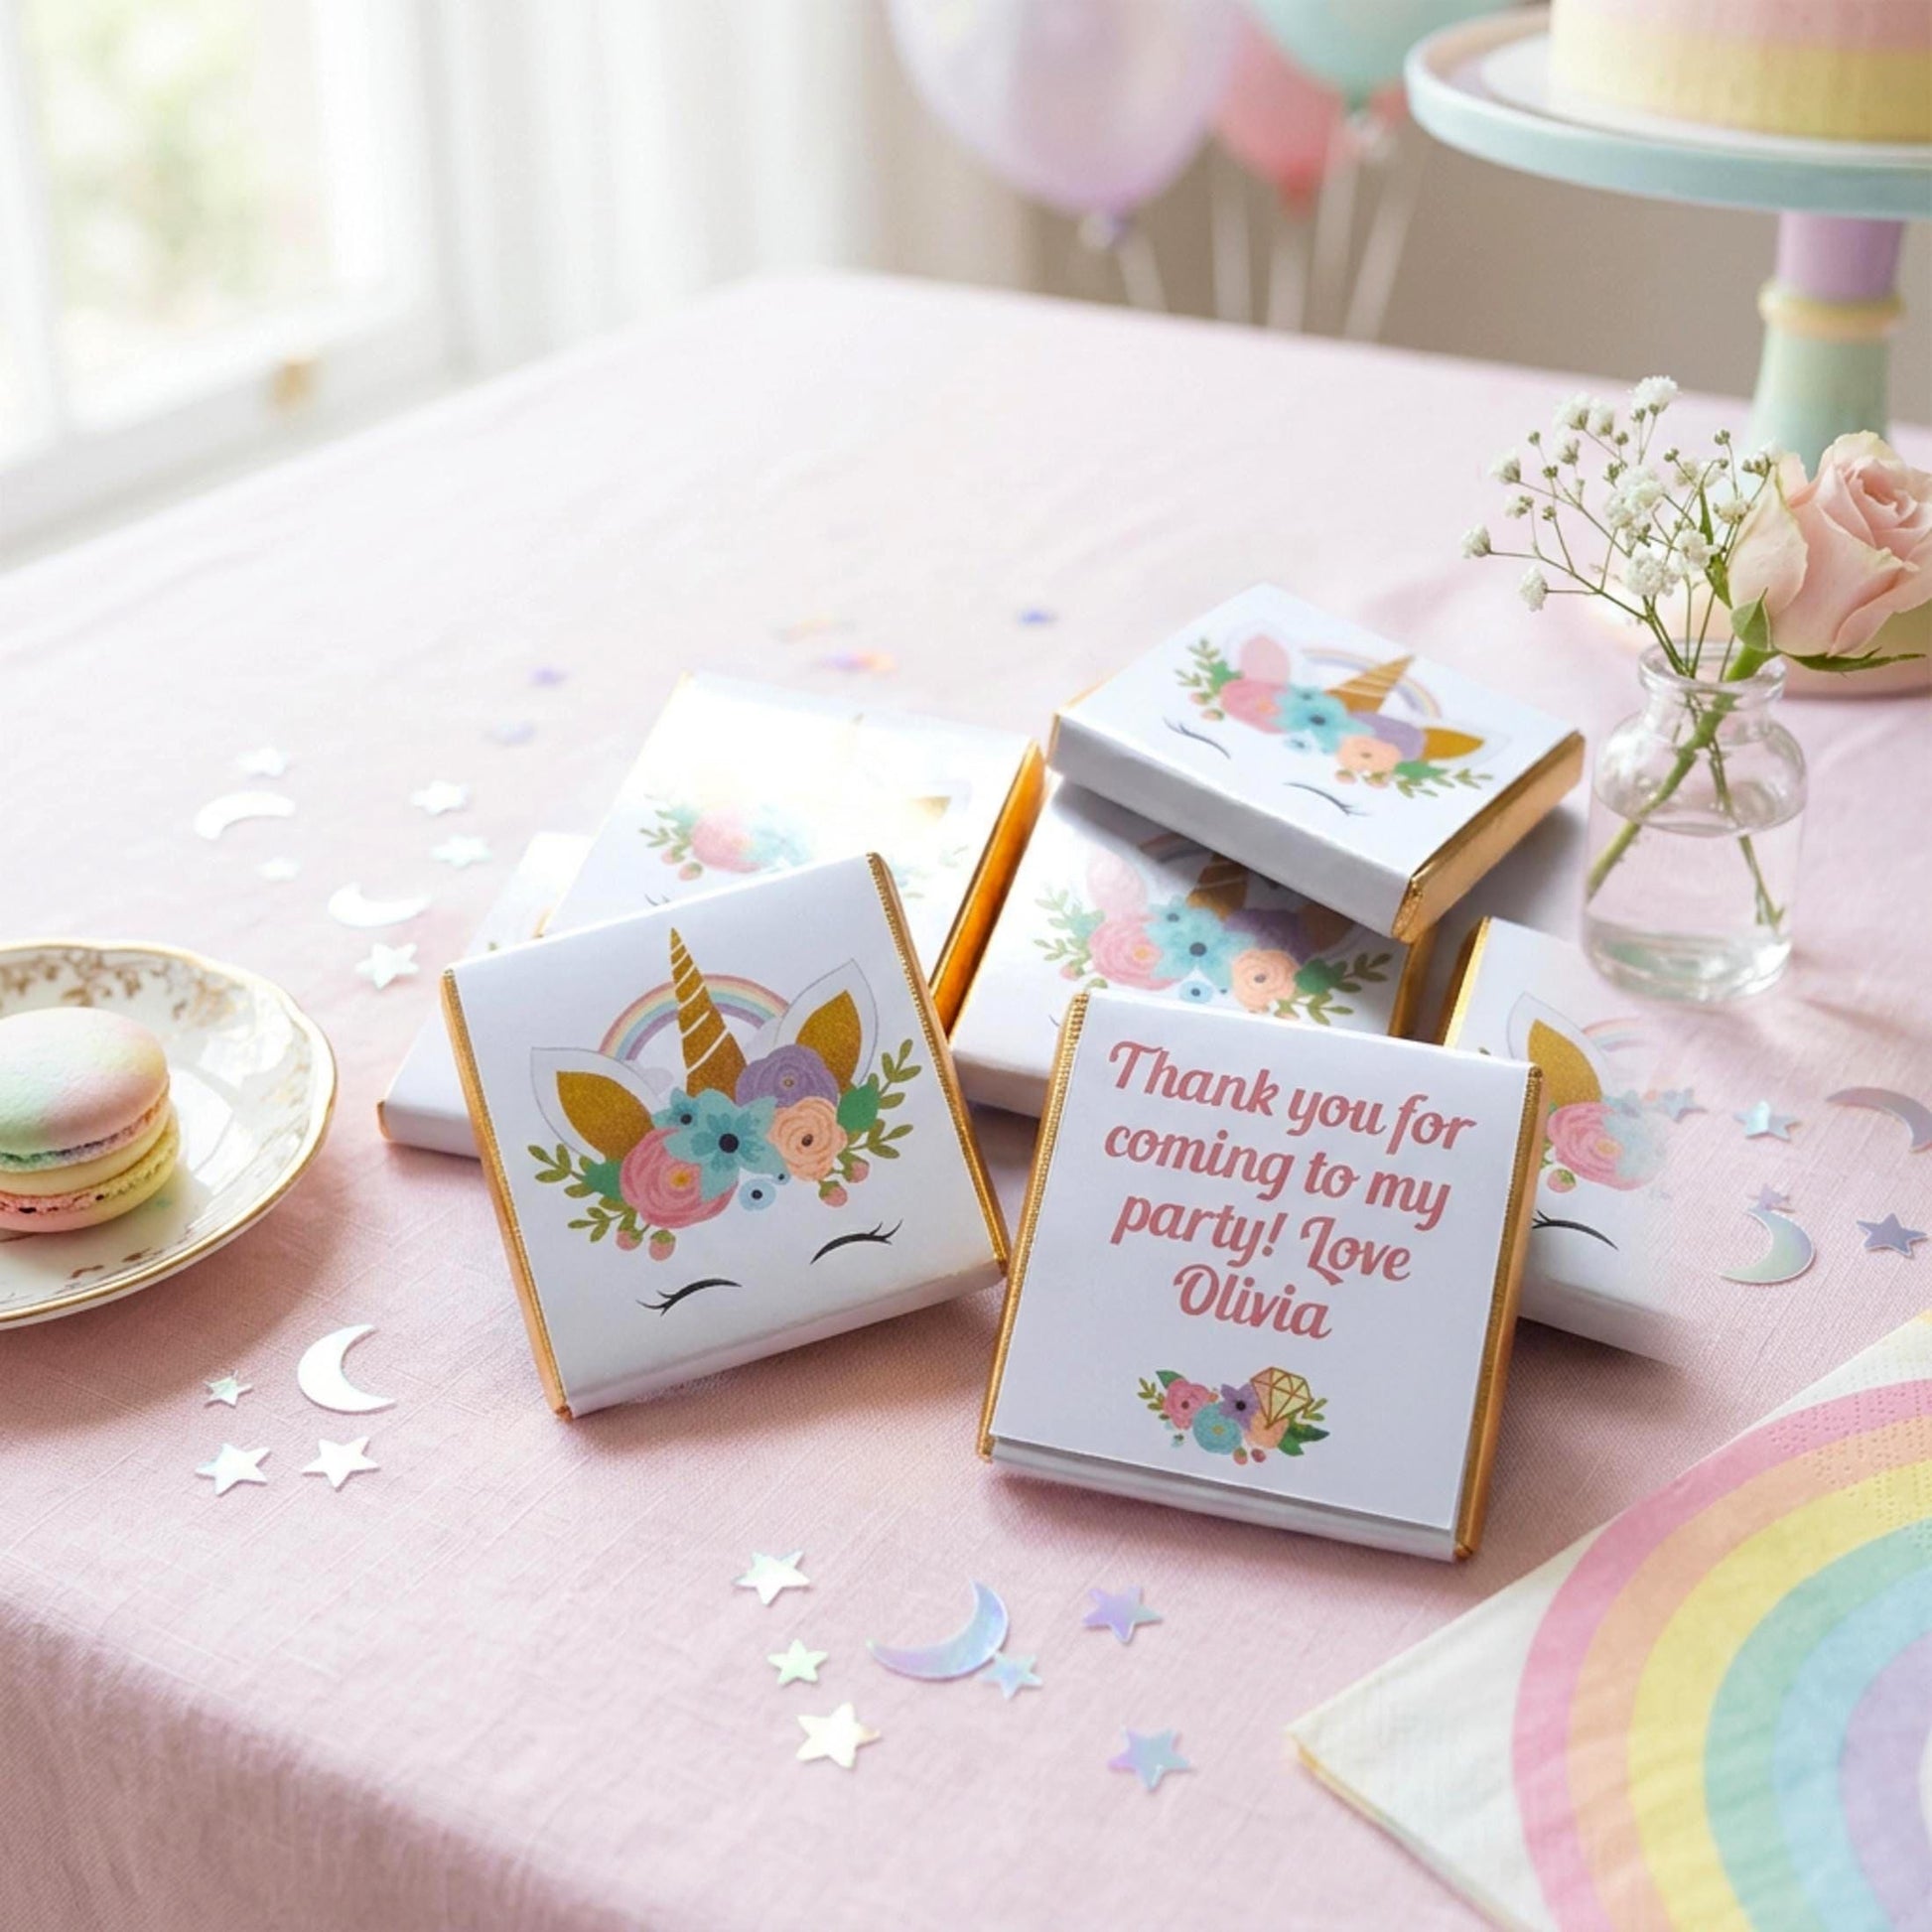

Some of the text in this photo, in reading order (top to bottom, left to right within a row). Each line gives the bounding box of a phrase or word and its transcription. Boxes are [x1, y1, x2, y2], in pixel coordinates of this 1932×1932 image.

[1109, 1040, 1477, 1156] Thank you for
[1104, 1125, 1451, 1232] coming to my
[1109, 1194, 1412, 1287] party! Love
[1173, 1263, 1333, 1340] Olivia
